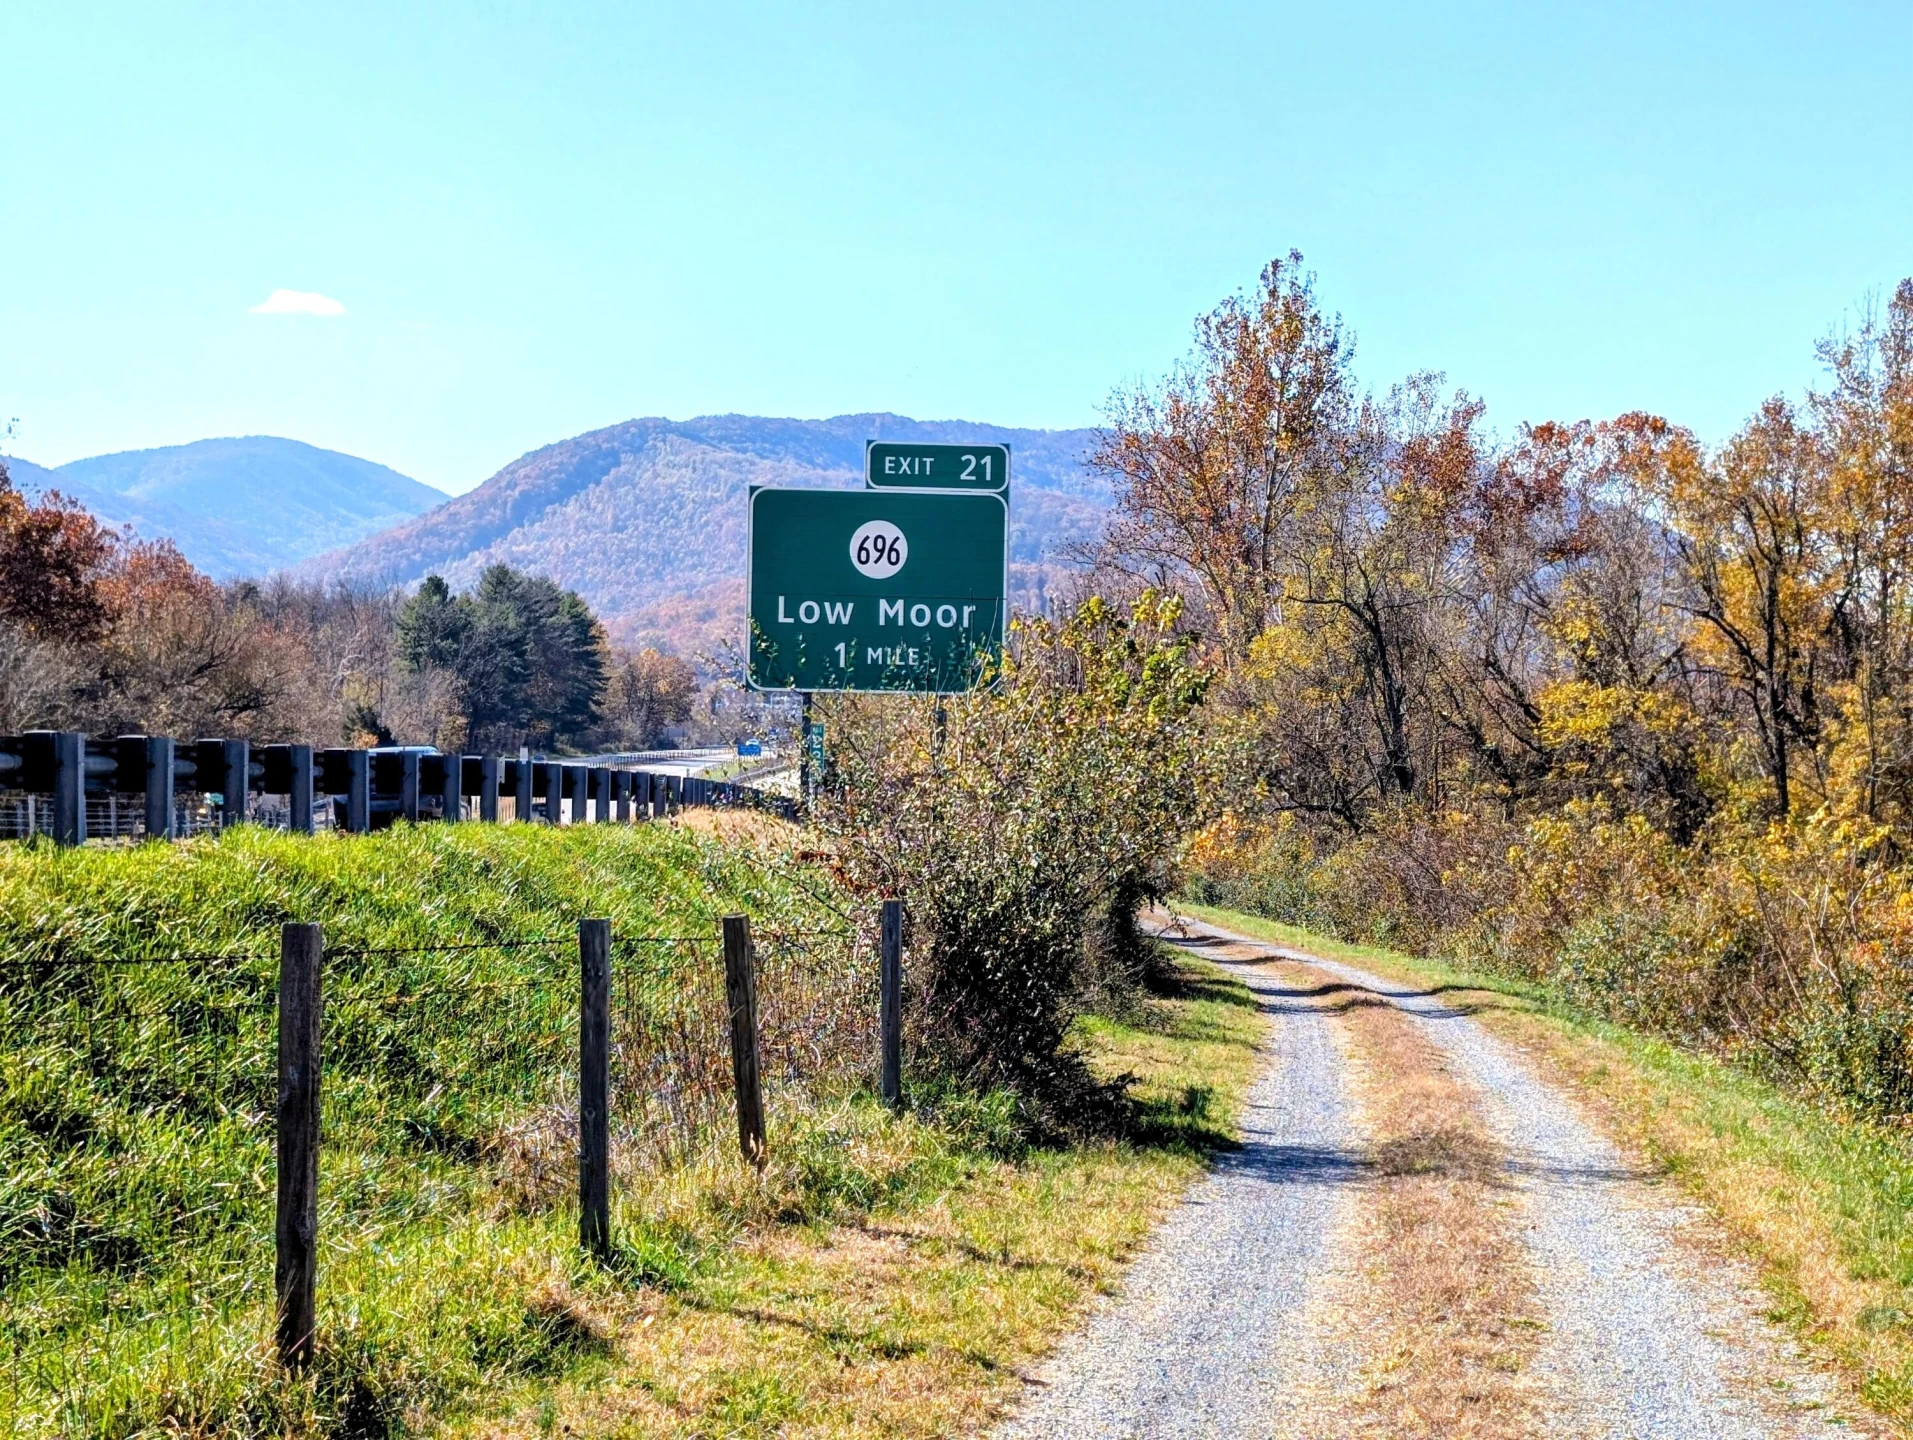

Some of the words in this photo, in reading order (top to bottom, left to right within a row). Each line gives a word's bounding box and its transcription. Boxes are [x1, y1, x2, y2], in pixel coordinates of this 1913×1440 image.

[884, 456, 935, 475] EXIT
[959, 454, 992, 481] 21
[856, 534, 901, 566] 696
[777, 595, 855, 625] Low
[879, 598, 976, 628] Moor
[833, 641, 846, 668] 1
[867, 646, 920, 667] MILE
